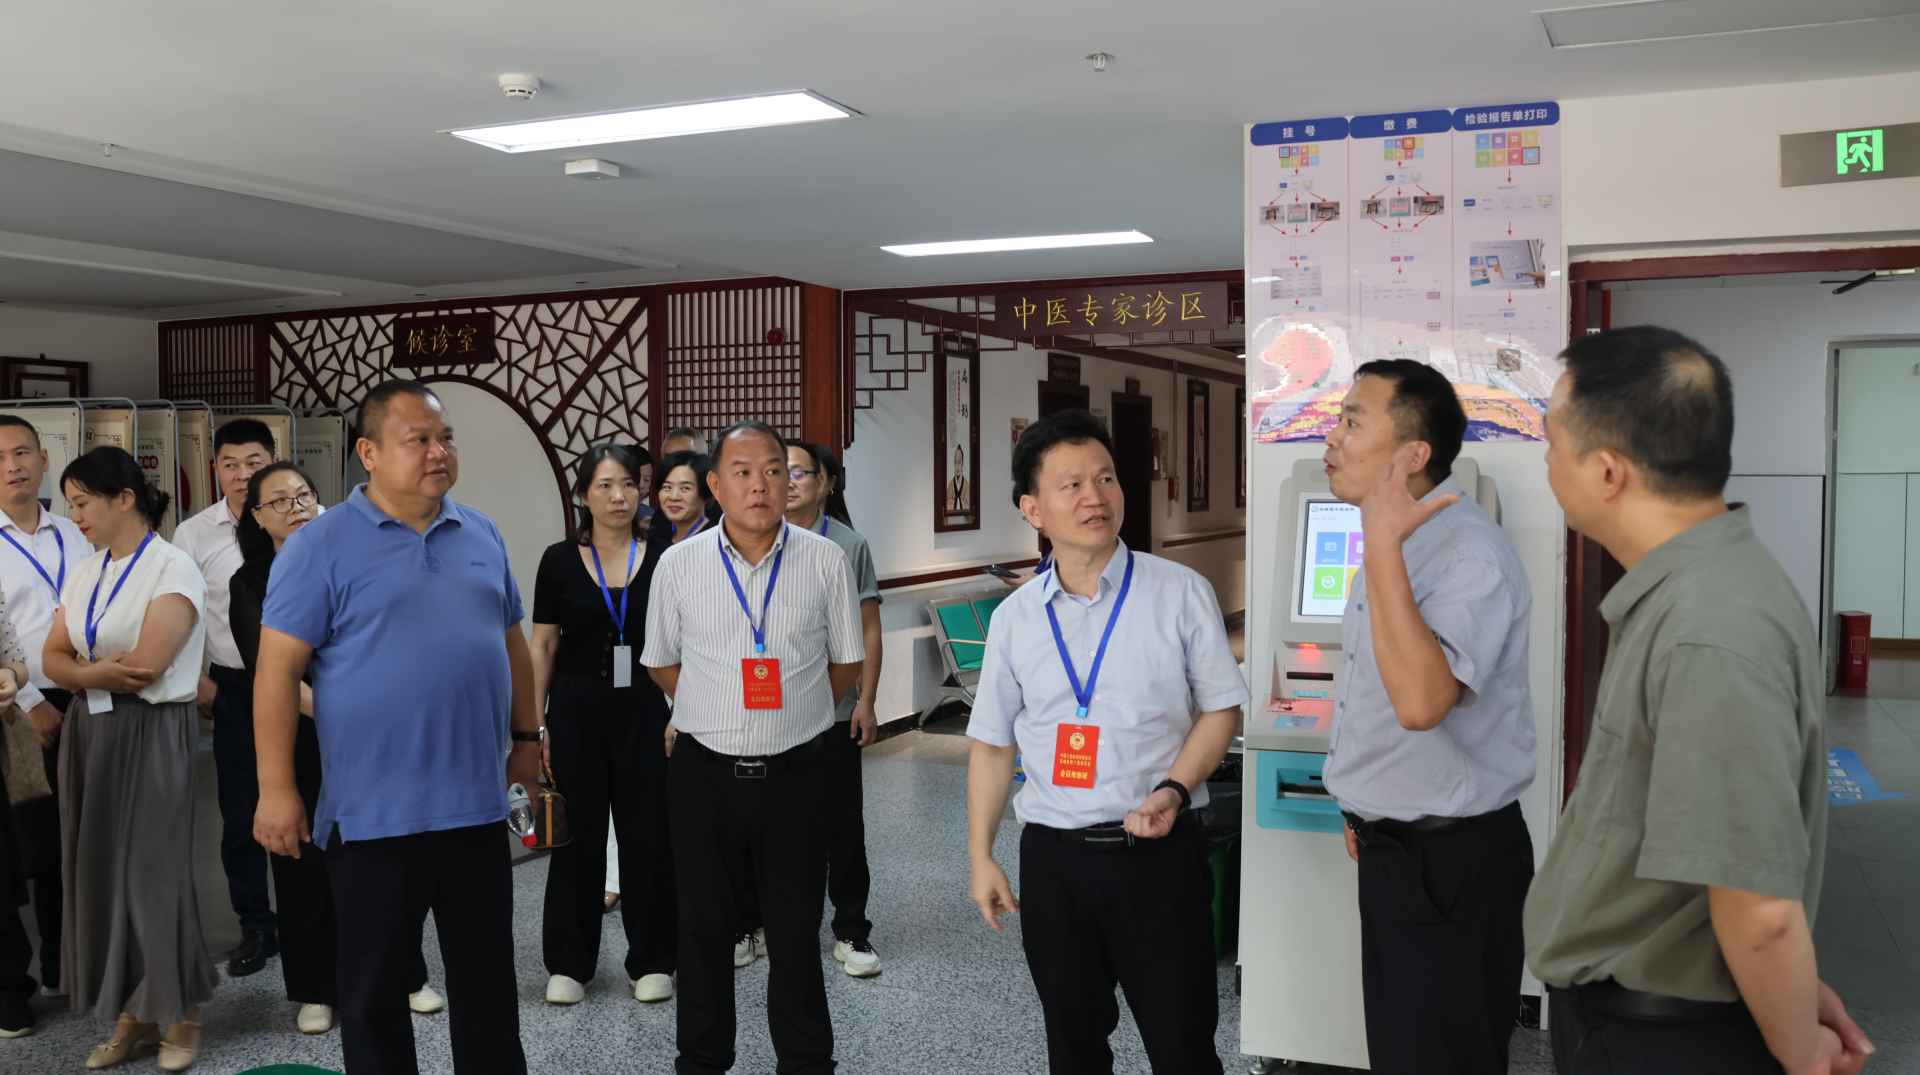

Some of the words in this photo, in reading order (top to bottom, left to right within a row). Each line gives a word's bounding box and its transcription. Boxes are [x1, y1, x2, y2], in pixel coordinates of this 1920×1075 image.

[1465, 108, 1548, 125] 检验报告单打印
[1013, 291, 1208, 329] 中医专家诊区
[406, 323, 478, 355] 候诊室
